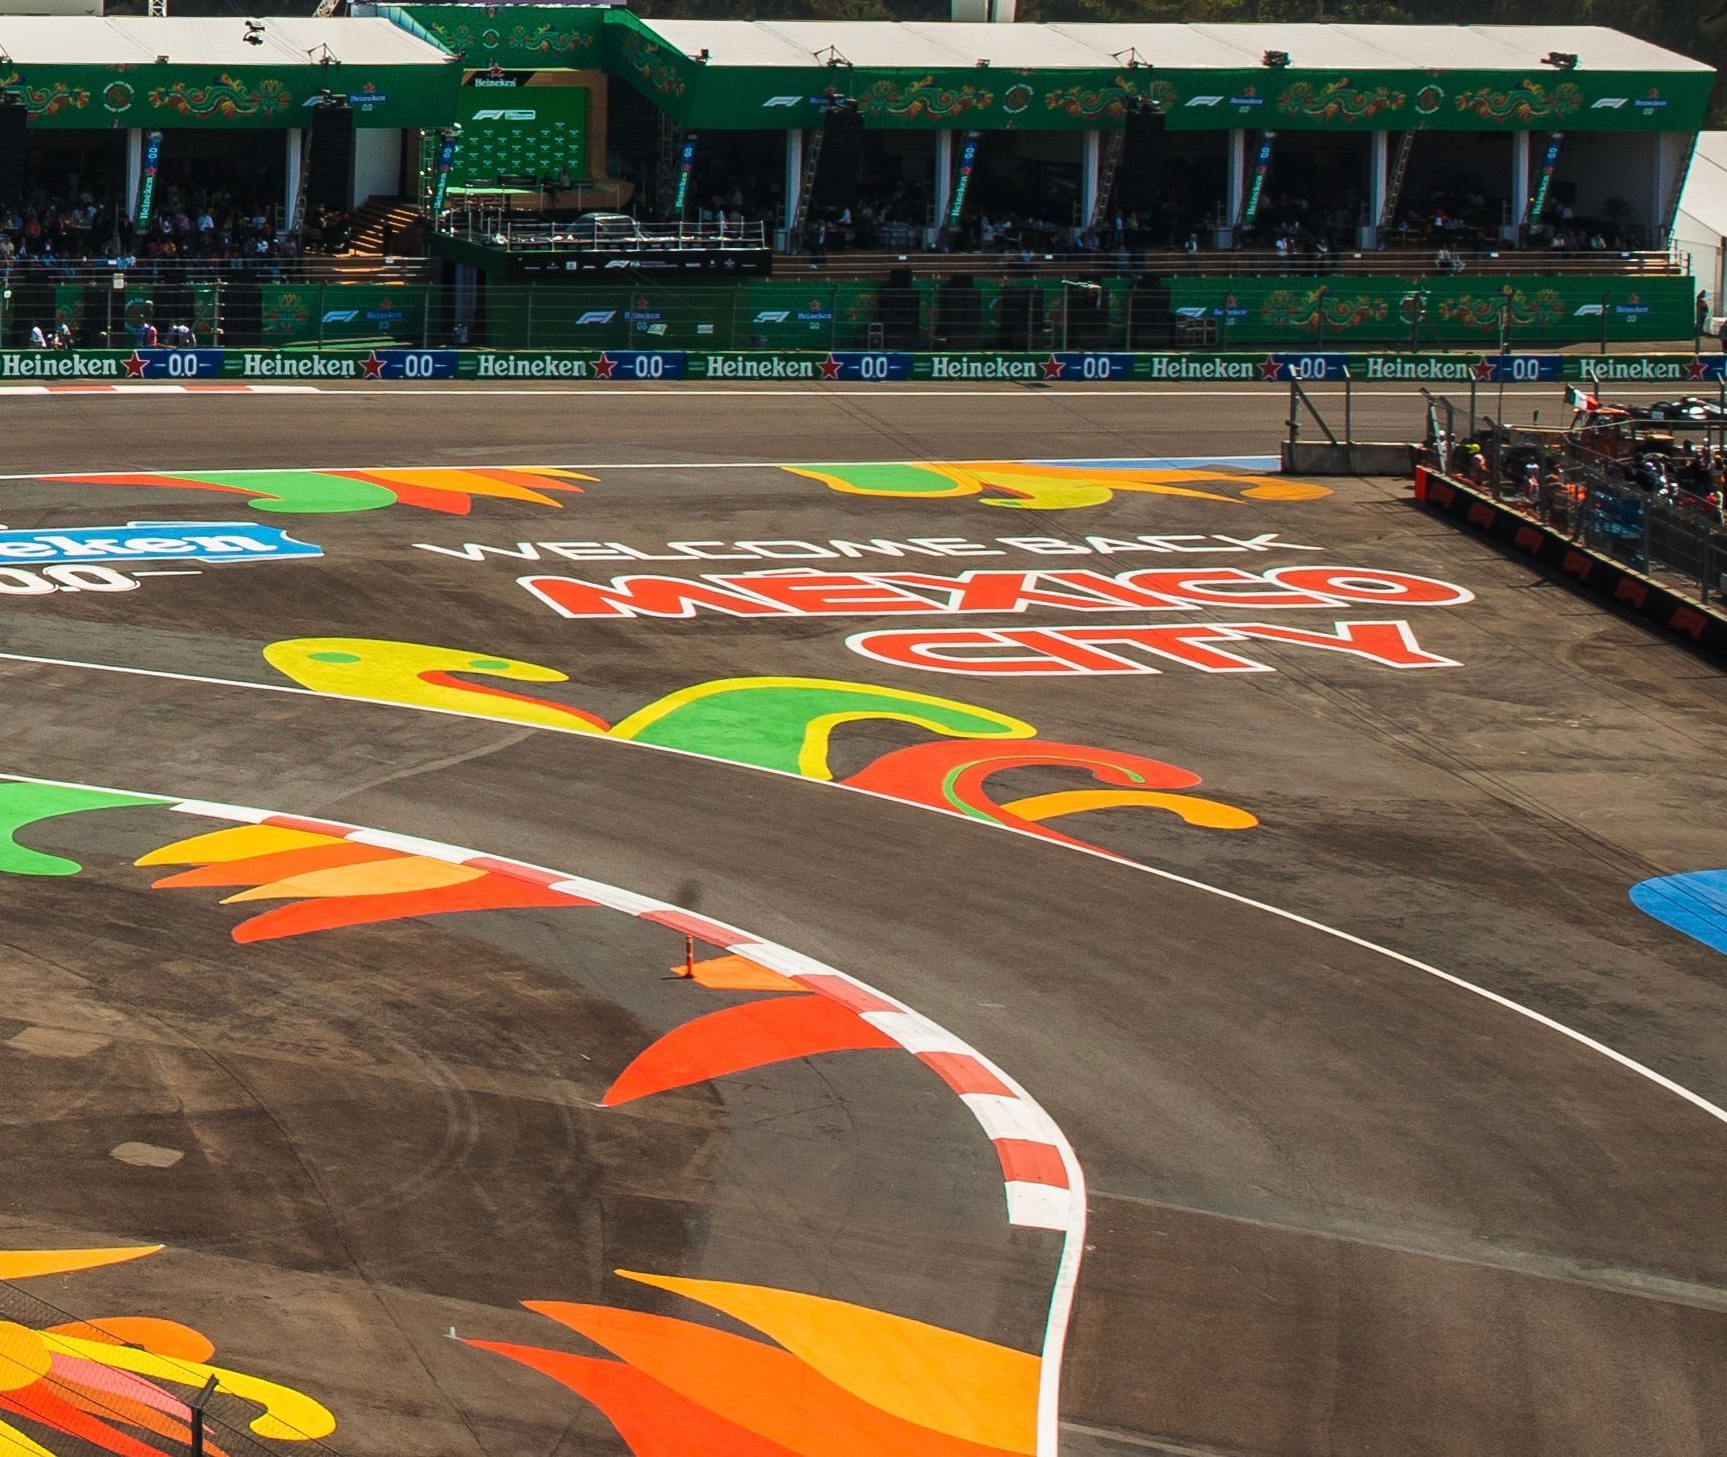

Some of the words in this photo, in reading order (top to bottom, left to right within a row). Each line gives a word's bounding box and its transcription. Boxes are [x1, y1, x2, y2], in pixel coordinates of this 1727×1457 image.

[140, 177, 154, 221] Heineken
[2, 354, 118, 376] Heineken
[244, 354, 356, 375] Heineken
[477, 355, 587, 376] Heineken
[706, 356, 814, 377] Heineken
[932, 357, 1038, 377] Heineken
[1151, 357, 1254, 377] Heineken
[1367, 358, 1468, 378] Heineken
[1579, 359, 1681, 378] Heineken
[411, 537, 1007, 561] WELCOME
[996, 533, 1324, 556] BACK
[515, 565, 1475, 619] MÉXICO
[842, 619, 1465, 676] CITY
